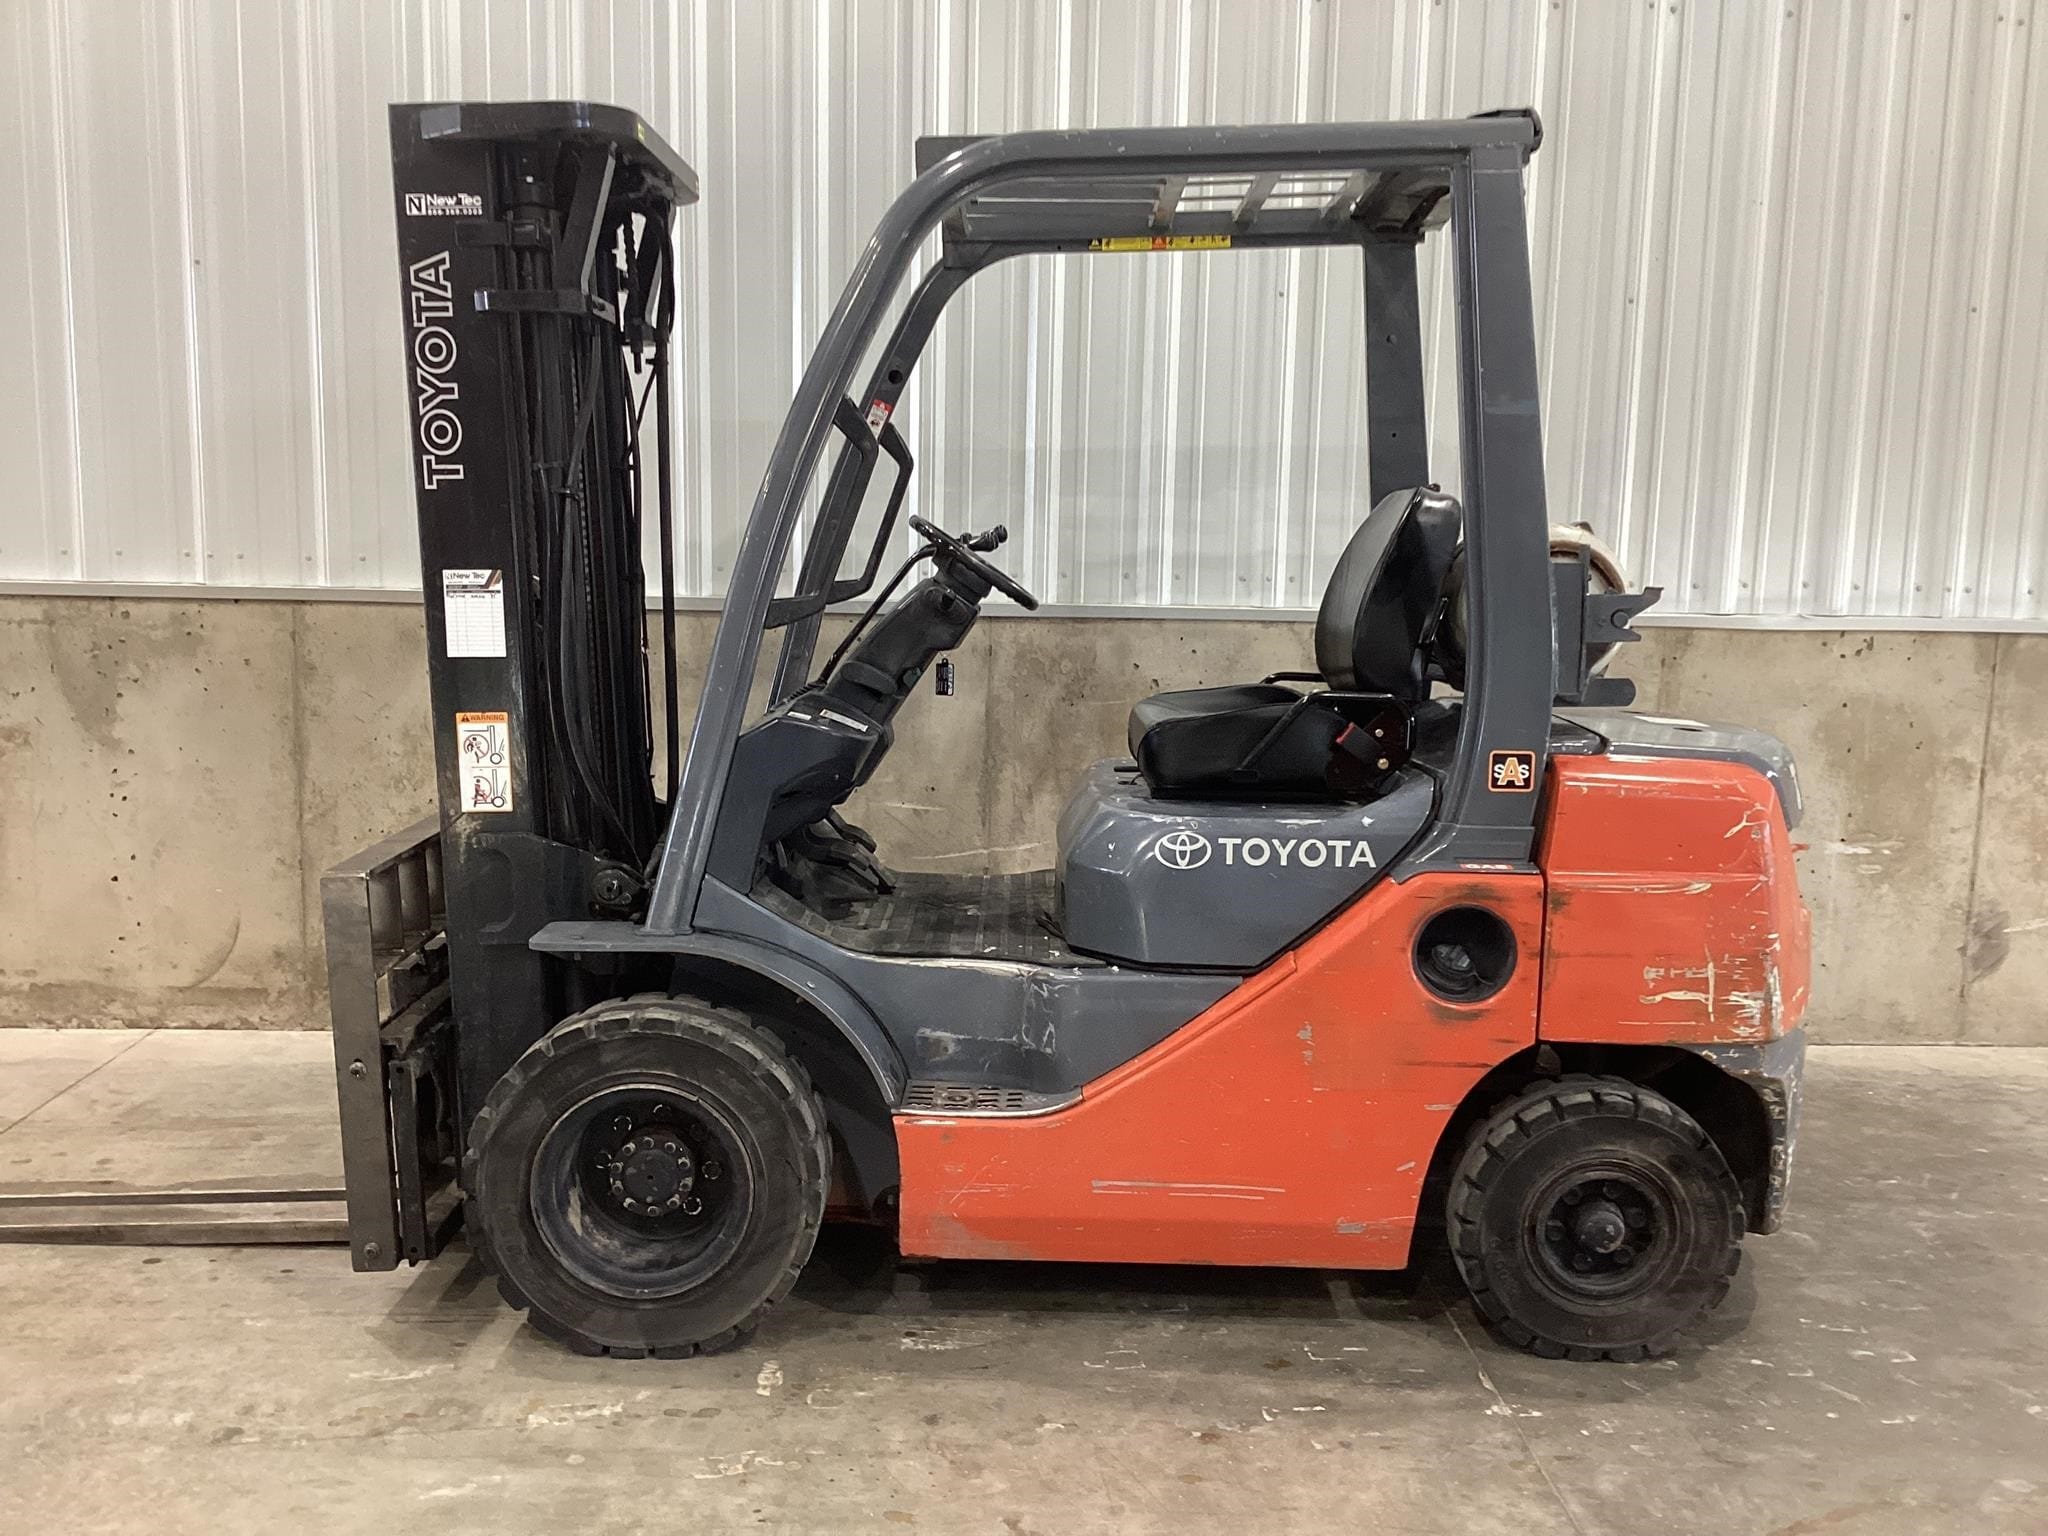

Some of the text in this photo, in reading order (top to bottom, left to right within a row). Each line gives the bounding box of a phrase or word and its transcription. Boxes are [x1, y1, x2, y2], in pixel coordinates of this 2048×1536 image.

[426, 193, 457, 206] New
[457, 192, 482, 206] Tec
[409, 250, 464, 490] TOYOTA
[1218, 838, 1377, 868] TOYOTA
